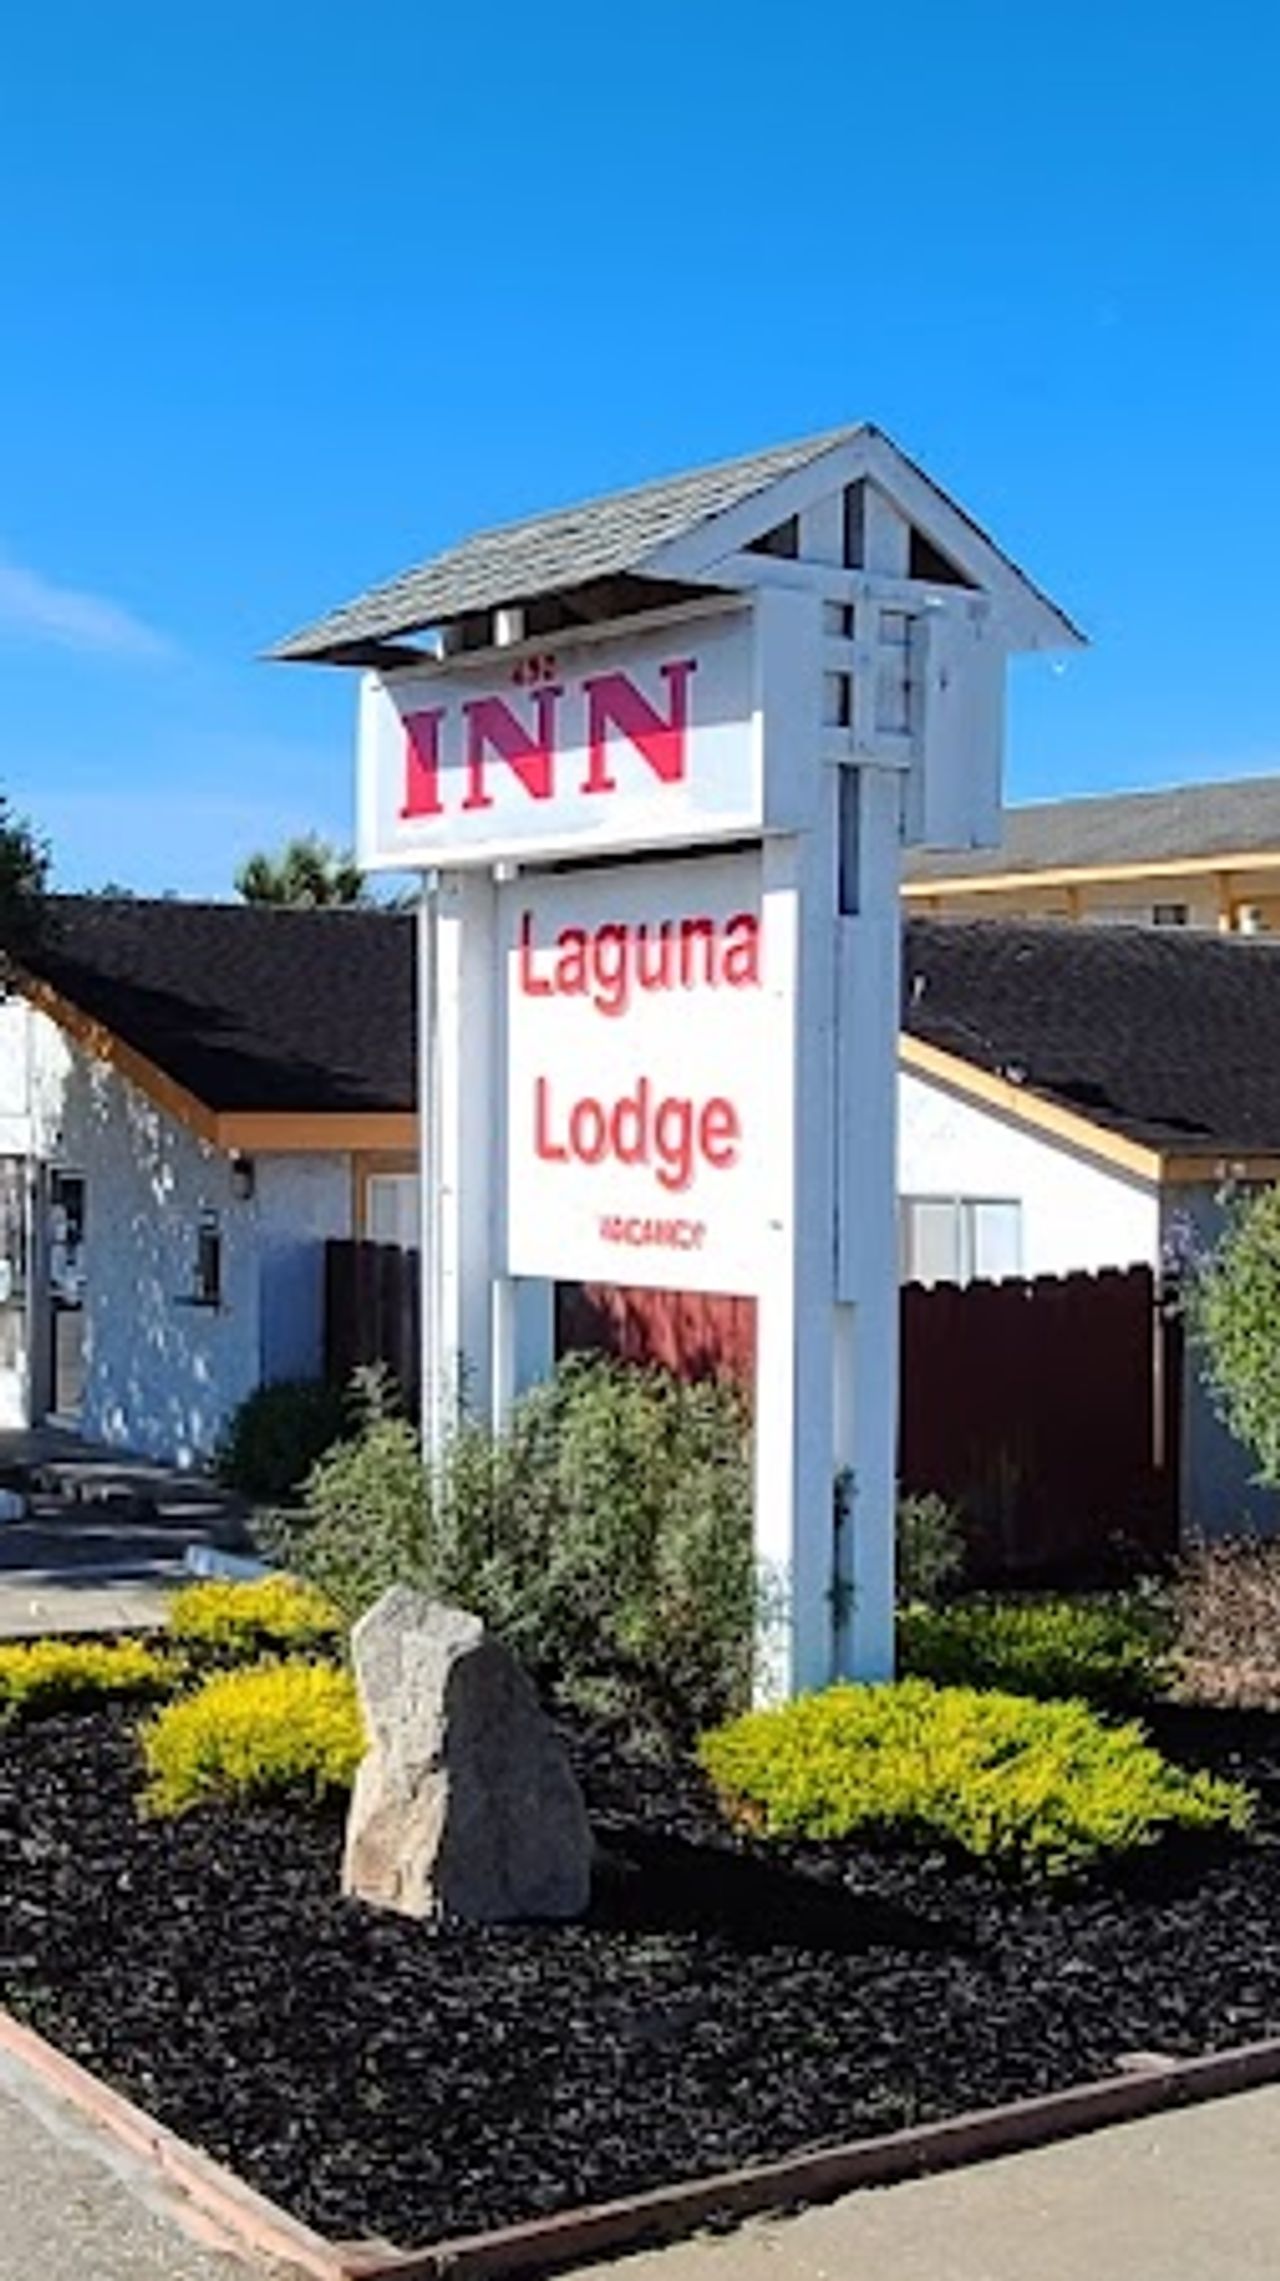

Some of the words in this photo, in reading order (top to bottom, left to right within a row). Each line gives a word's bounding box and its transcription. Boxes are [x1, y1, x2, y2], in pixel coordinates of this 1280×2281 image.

[400, 659, 697, 820] INN
[520, 909, 763, 1016] Laguna
[534, 1076, 741, 1191] Lodge
